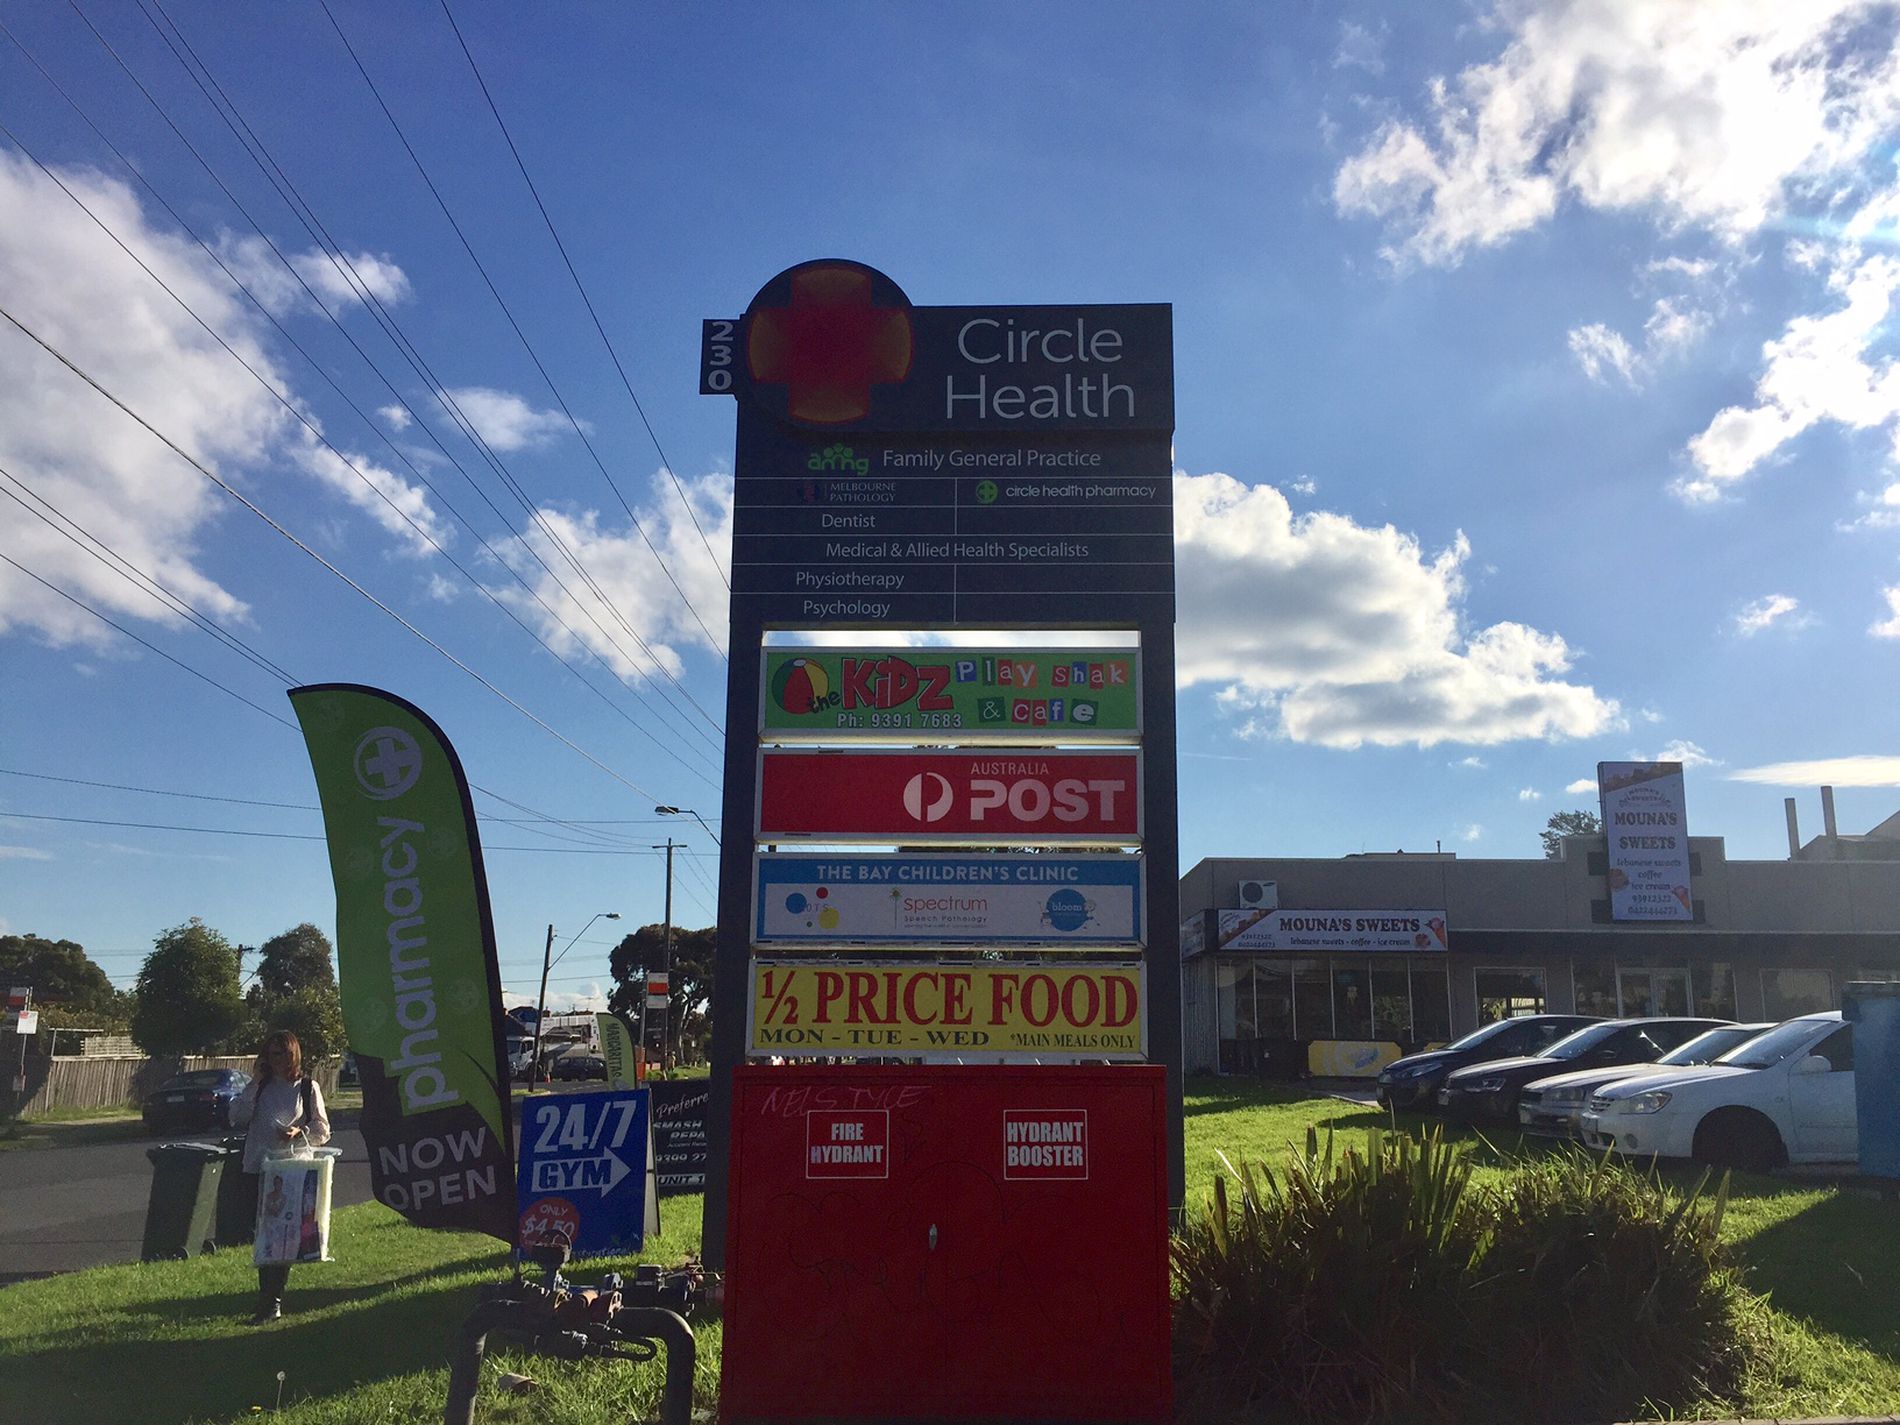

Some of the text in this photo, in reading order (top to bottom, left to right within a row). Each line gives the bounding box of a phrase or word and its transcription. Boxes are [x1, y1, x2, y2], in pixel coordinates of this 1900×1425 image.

[957, 318, 1123, 364] Circle
[946, 374, 1135, 419] Health
[884, 449, 1101, 470] Family General Practice
[830, 482, 896, 492] MELBOURNE
[1005, 484, 1156, 501] circle health pharmacy
[829, 493, 896, 502] PATHOLOGY
[822, 514, 876, 529] Dentist
[826, 542, 1089, 561] Medical & Allied Health Specialists
[796, 571, 905, 590] Physiotherapy
[803, 600, 891, 618] Psychology
[807, 691, 841, 714] the
[983, 701, 1001, 719] &
[837, 713, 963, 728] Ph: 9391 7683
[970, 762, 1050, 775] AUSTRALIA
[970, 779, 1126, 822] POST
[1615, 812, 1678, 826] MOUNA'S
[1619, 836, 1676, 850] SWEETS
[817, 865, 1079, 881] THE BAY CHILDREN'S CLINIC
[1638, 870, 1663, 881] coffee
[1052, 902, 1083, 911] bloom
[1279, 918, 1420, 932] MOUNA'S SWEETS
[1351, 937, 1371, 947] coffee
[376, 815, 459, 1111] pharmacy
[812, 971, 973, 1025] PRICE
[987, 972, 1138, 1029] FOOD
[759, 1029, 824, 1044] MON
[848, 1030, 902, 1045] TUE
[926, 1031, 989, 1046] WED
[1053, 1034, 1099, 1048] MEALS
[1101, 1035, 1136, 1049] ONLY
[656, 1092, 709, 1118] Preferre
[534, 1100, 637, 1154] 24/7
[831, 1123, 864, 1141] FIRE
[1007, 1122, 1083, 1142] HYDRANT
[378, 1126, 487, 1176] NOW
[810, 1145, 883, 1164] HYDRANT
[1007, 1146, 1083, 1166] BOOSTER
[538, 1159, 612, 1189] GYM
[659, 1175, 692, 1185] UNIT
[383, 1165, 498, 1212] OPEN
[540, 1204, 568, 1217] ONLY
[522, 1215, 575, 1237] $450
